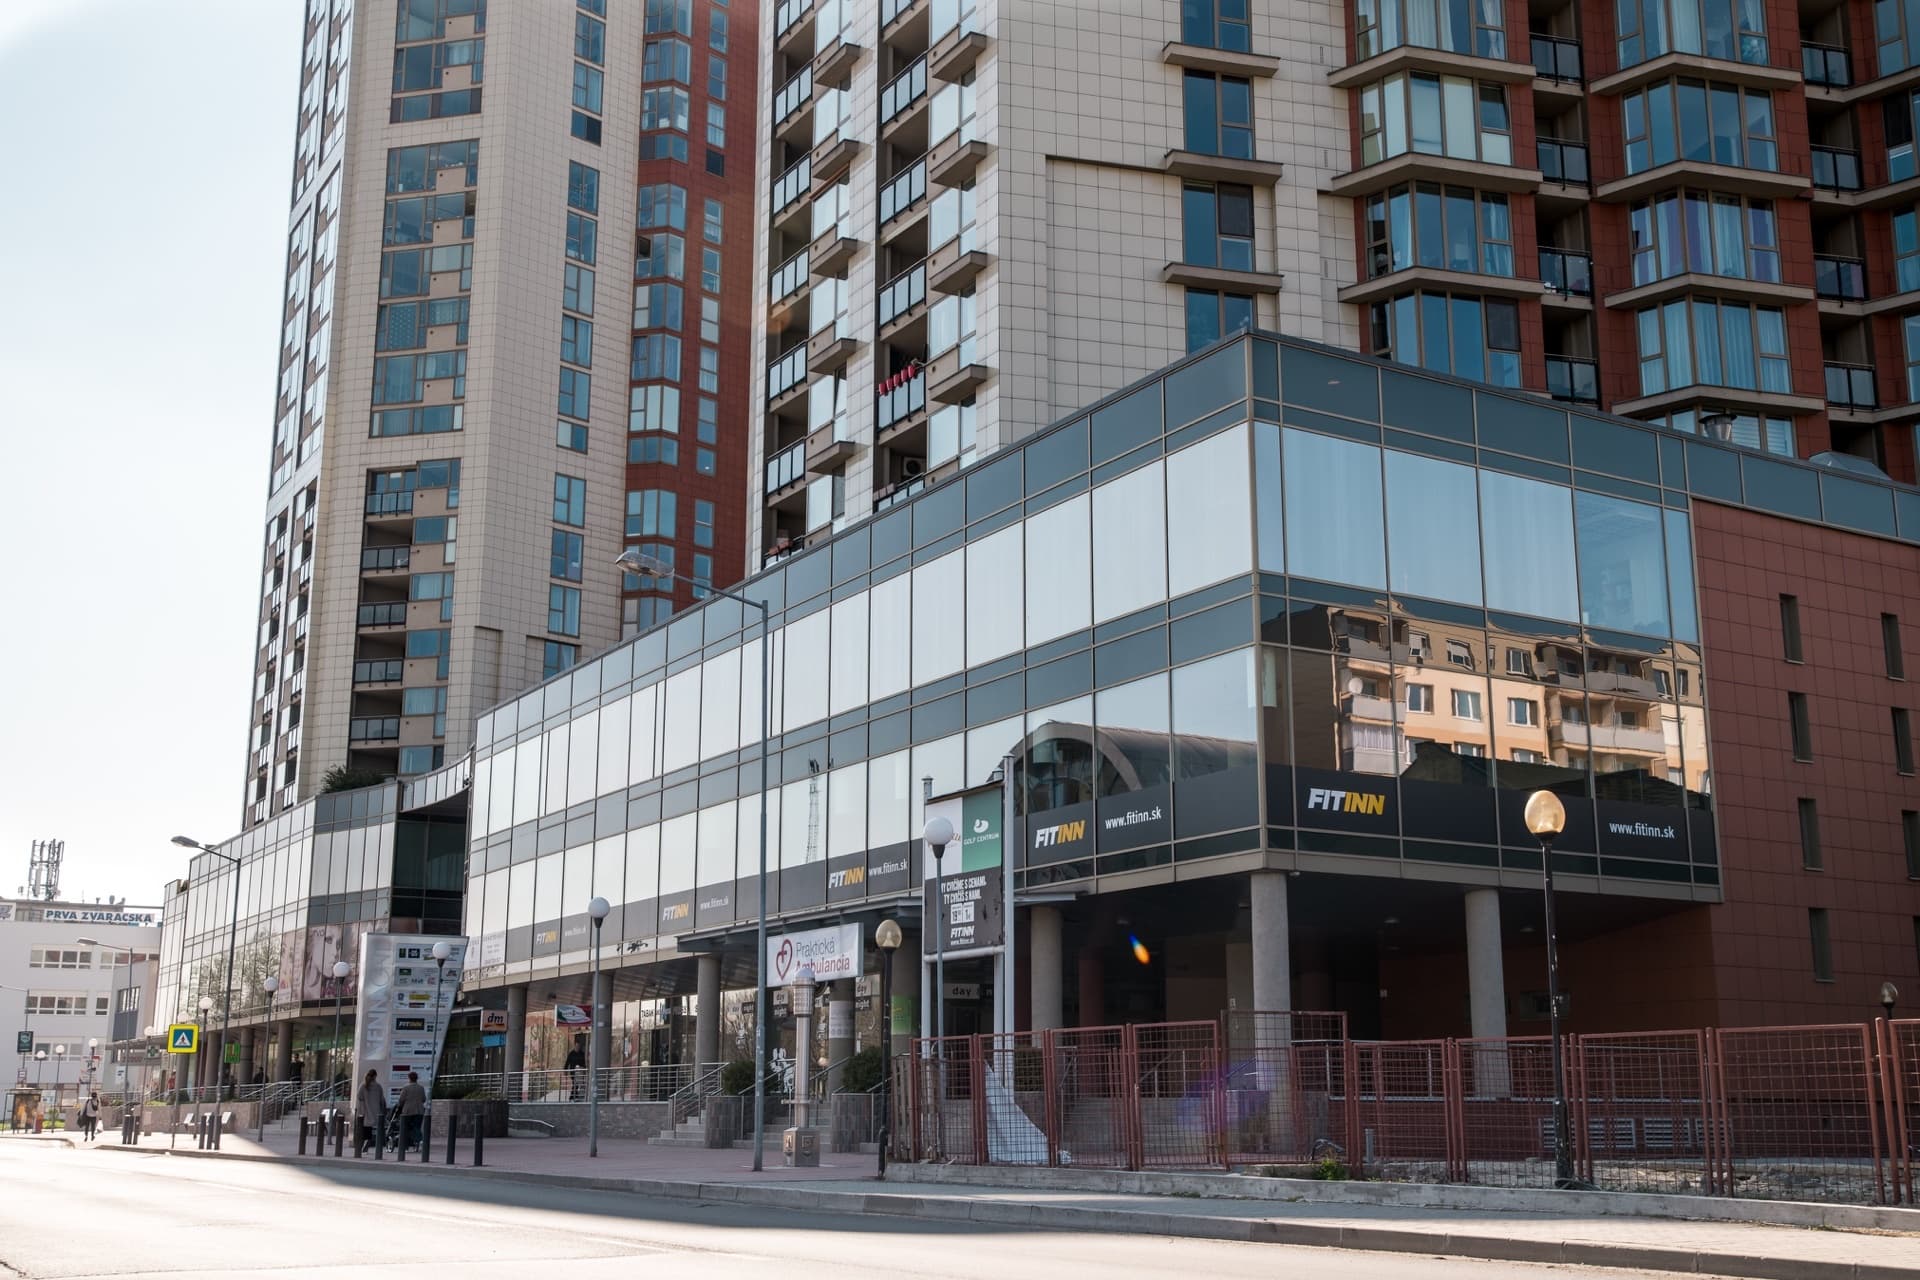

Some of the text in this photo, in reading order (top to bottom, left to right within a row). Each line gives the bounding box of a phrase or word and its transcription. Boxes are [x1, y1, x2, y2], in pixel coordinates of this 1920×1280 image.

[1308, 788, 1385, 815] FITINN
[1105, 806, 1162, 830] www.fitinn.sk
[1035, 820, 1086, 848] FITINN
[1609, 822, 1675, 839] www.fitinn.sk
[828, 866, 865, 889] FITINN
[869, 858, 908, 877] www.fitinn.sk
[950, 925, 975, 939] FITINN
[796, 937, 835, 958] Praktická
[488, 1013, 504, 1023] dm
